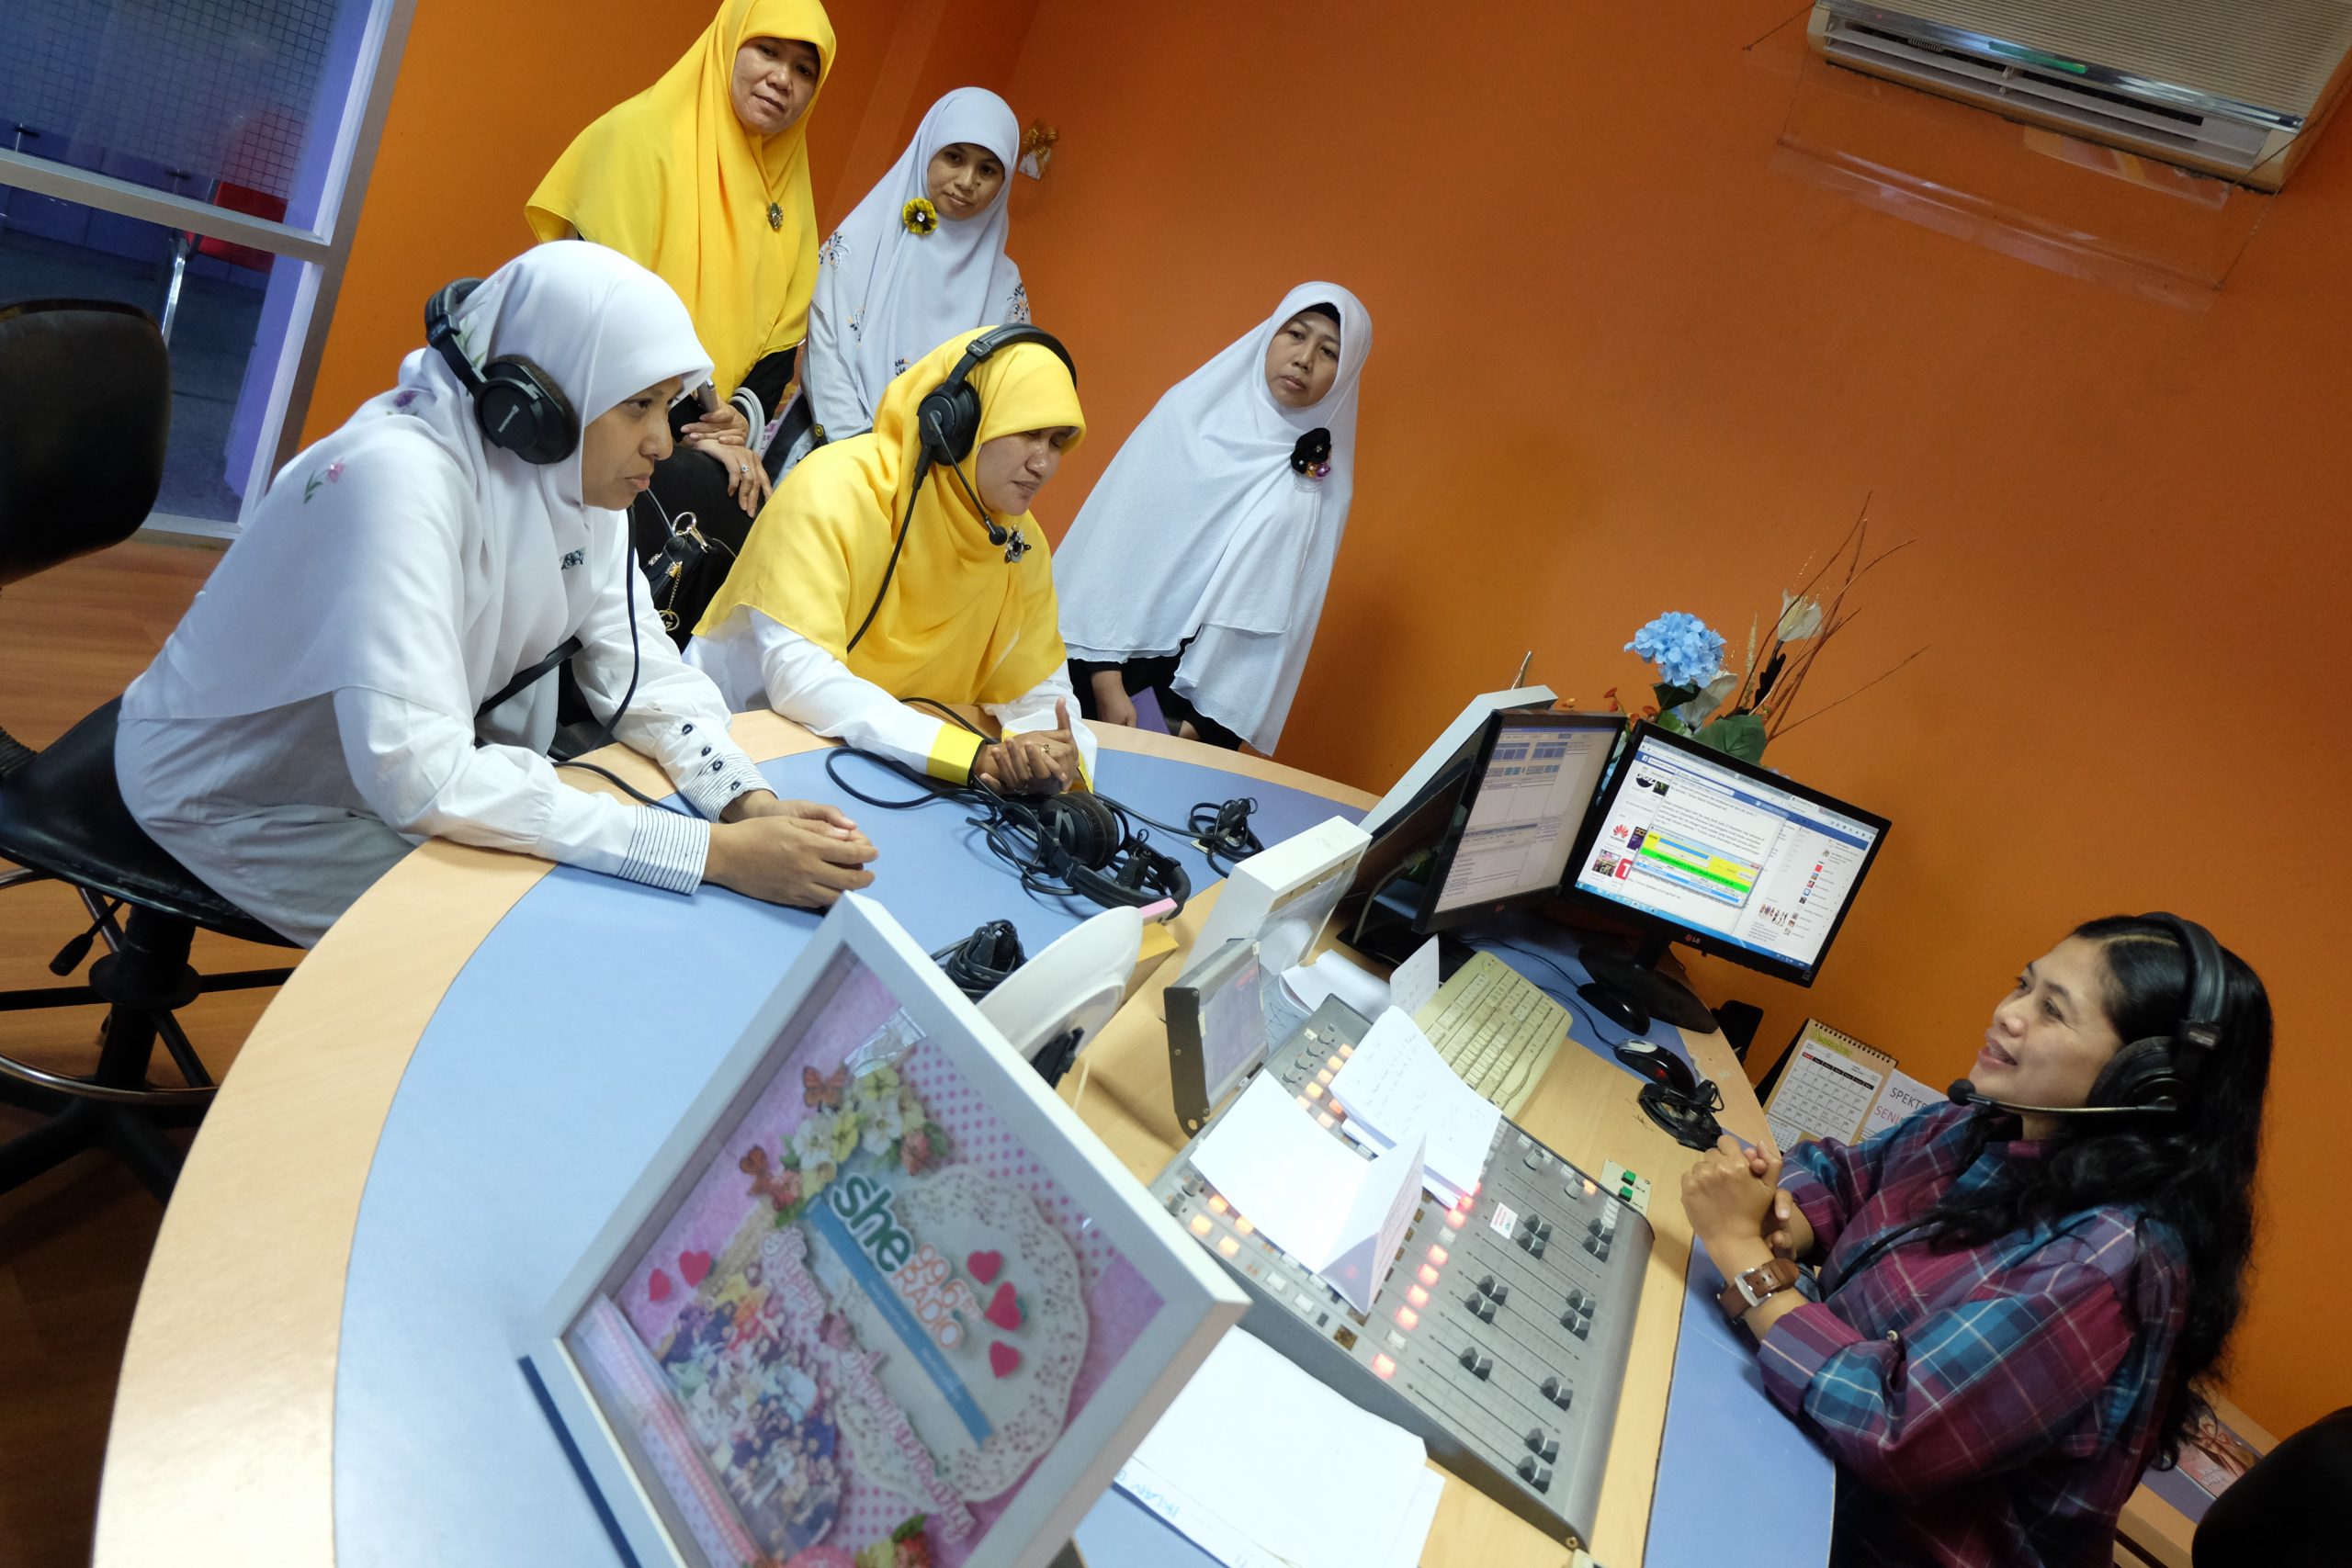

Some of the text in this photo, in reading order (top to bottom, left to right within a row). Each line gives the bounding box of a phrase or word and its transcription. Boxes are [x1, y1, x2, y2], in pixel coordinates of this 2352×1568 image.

[1692, 935, 1701, 944] LG
[1874, 1105, 1904, 1125] SENI
[763, 1226, 826, 1322] Happy
[891, 1264, 964, 1350] RADIO
[840, 1350, 977, 1543] Anniversary
